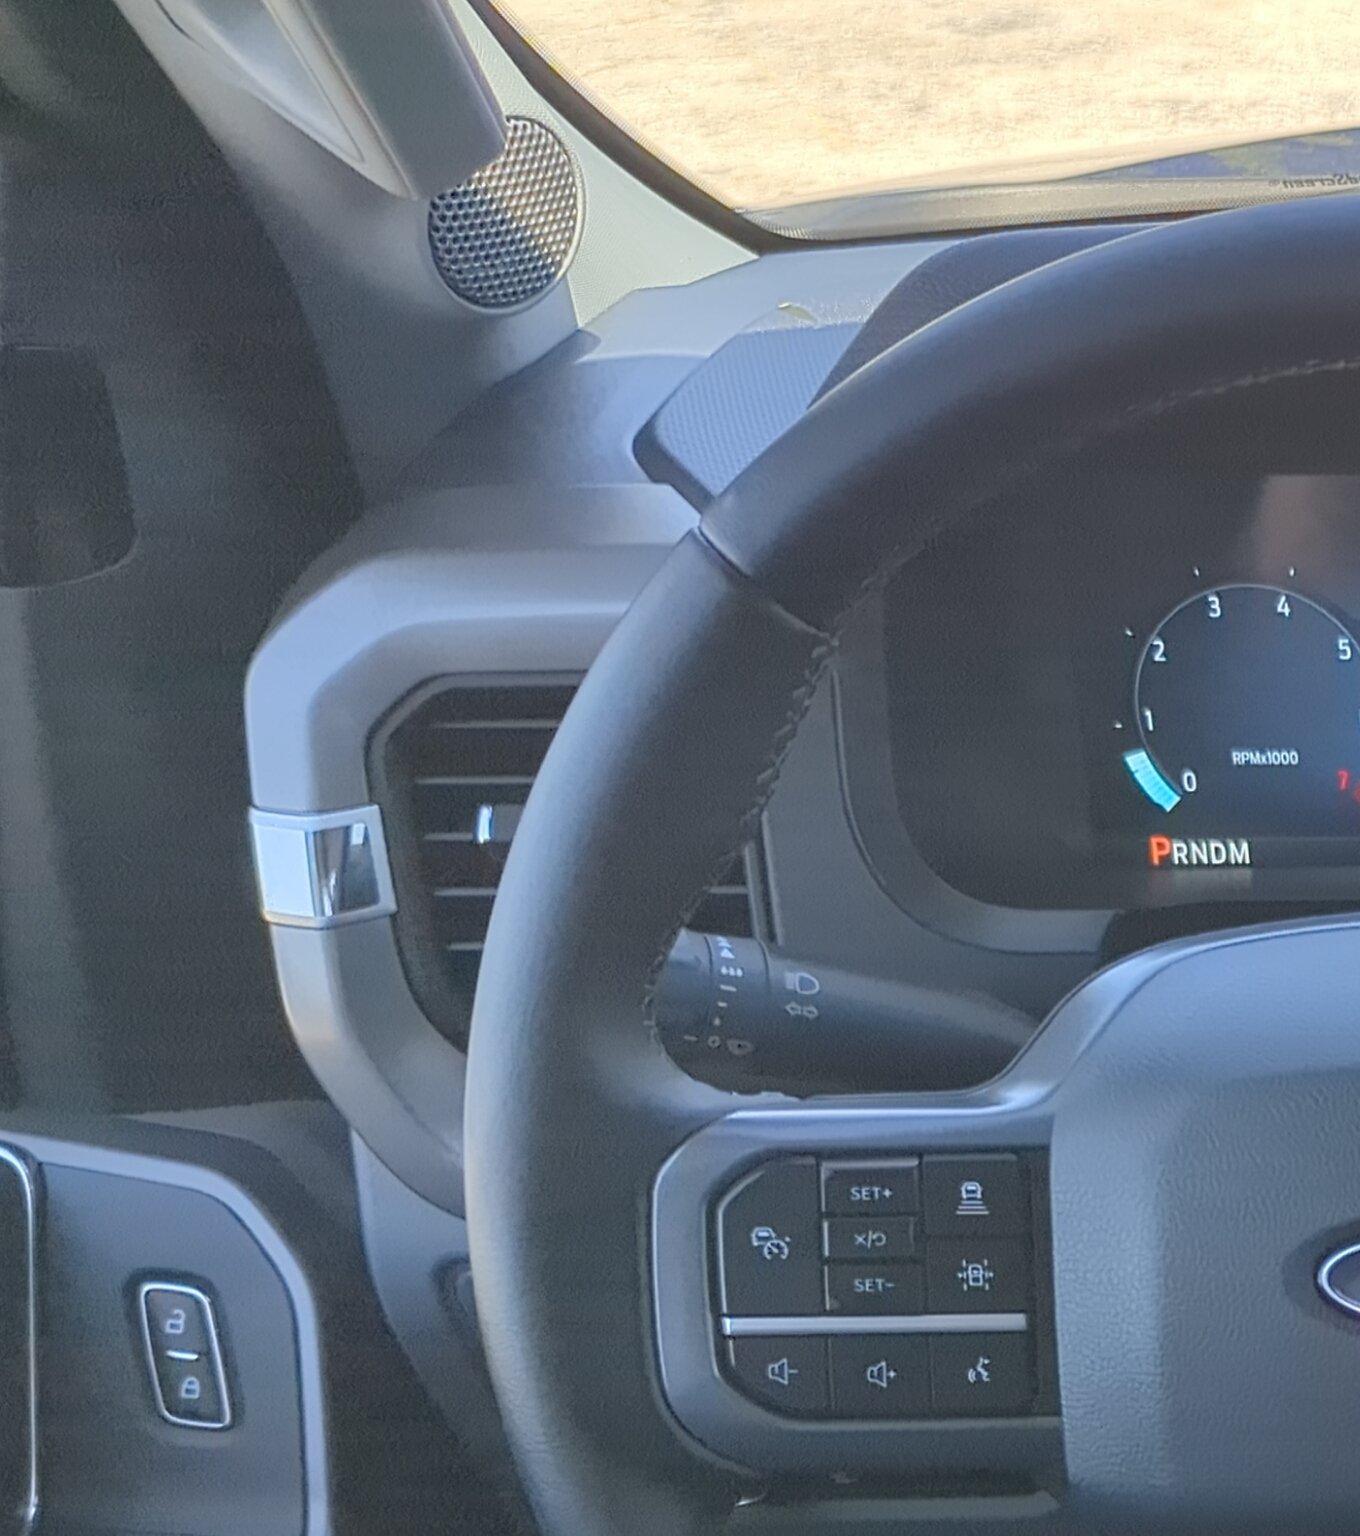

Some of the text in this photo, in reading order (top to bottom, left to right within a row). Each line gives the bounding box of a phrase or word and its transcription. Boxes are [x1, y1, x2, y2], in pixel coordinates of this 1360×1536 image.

[1208, 596, 1221, 618] 3
[1276, 595, 1291, 617] 4
[1152, 640, 1166, 663] 2
[1338, 639, 1352, 660] 5
[1143, 709, 1154, 730] 1
[1232, 750, 1299, 766] RPMx1000
[1182, 769, 1198, 793] 0
[850, 1187, 893, 1201] SET+
